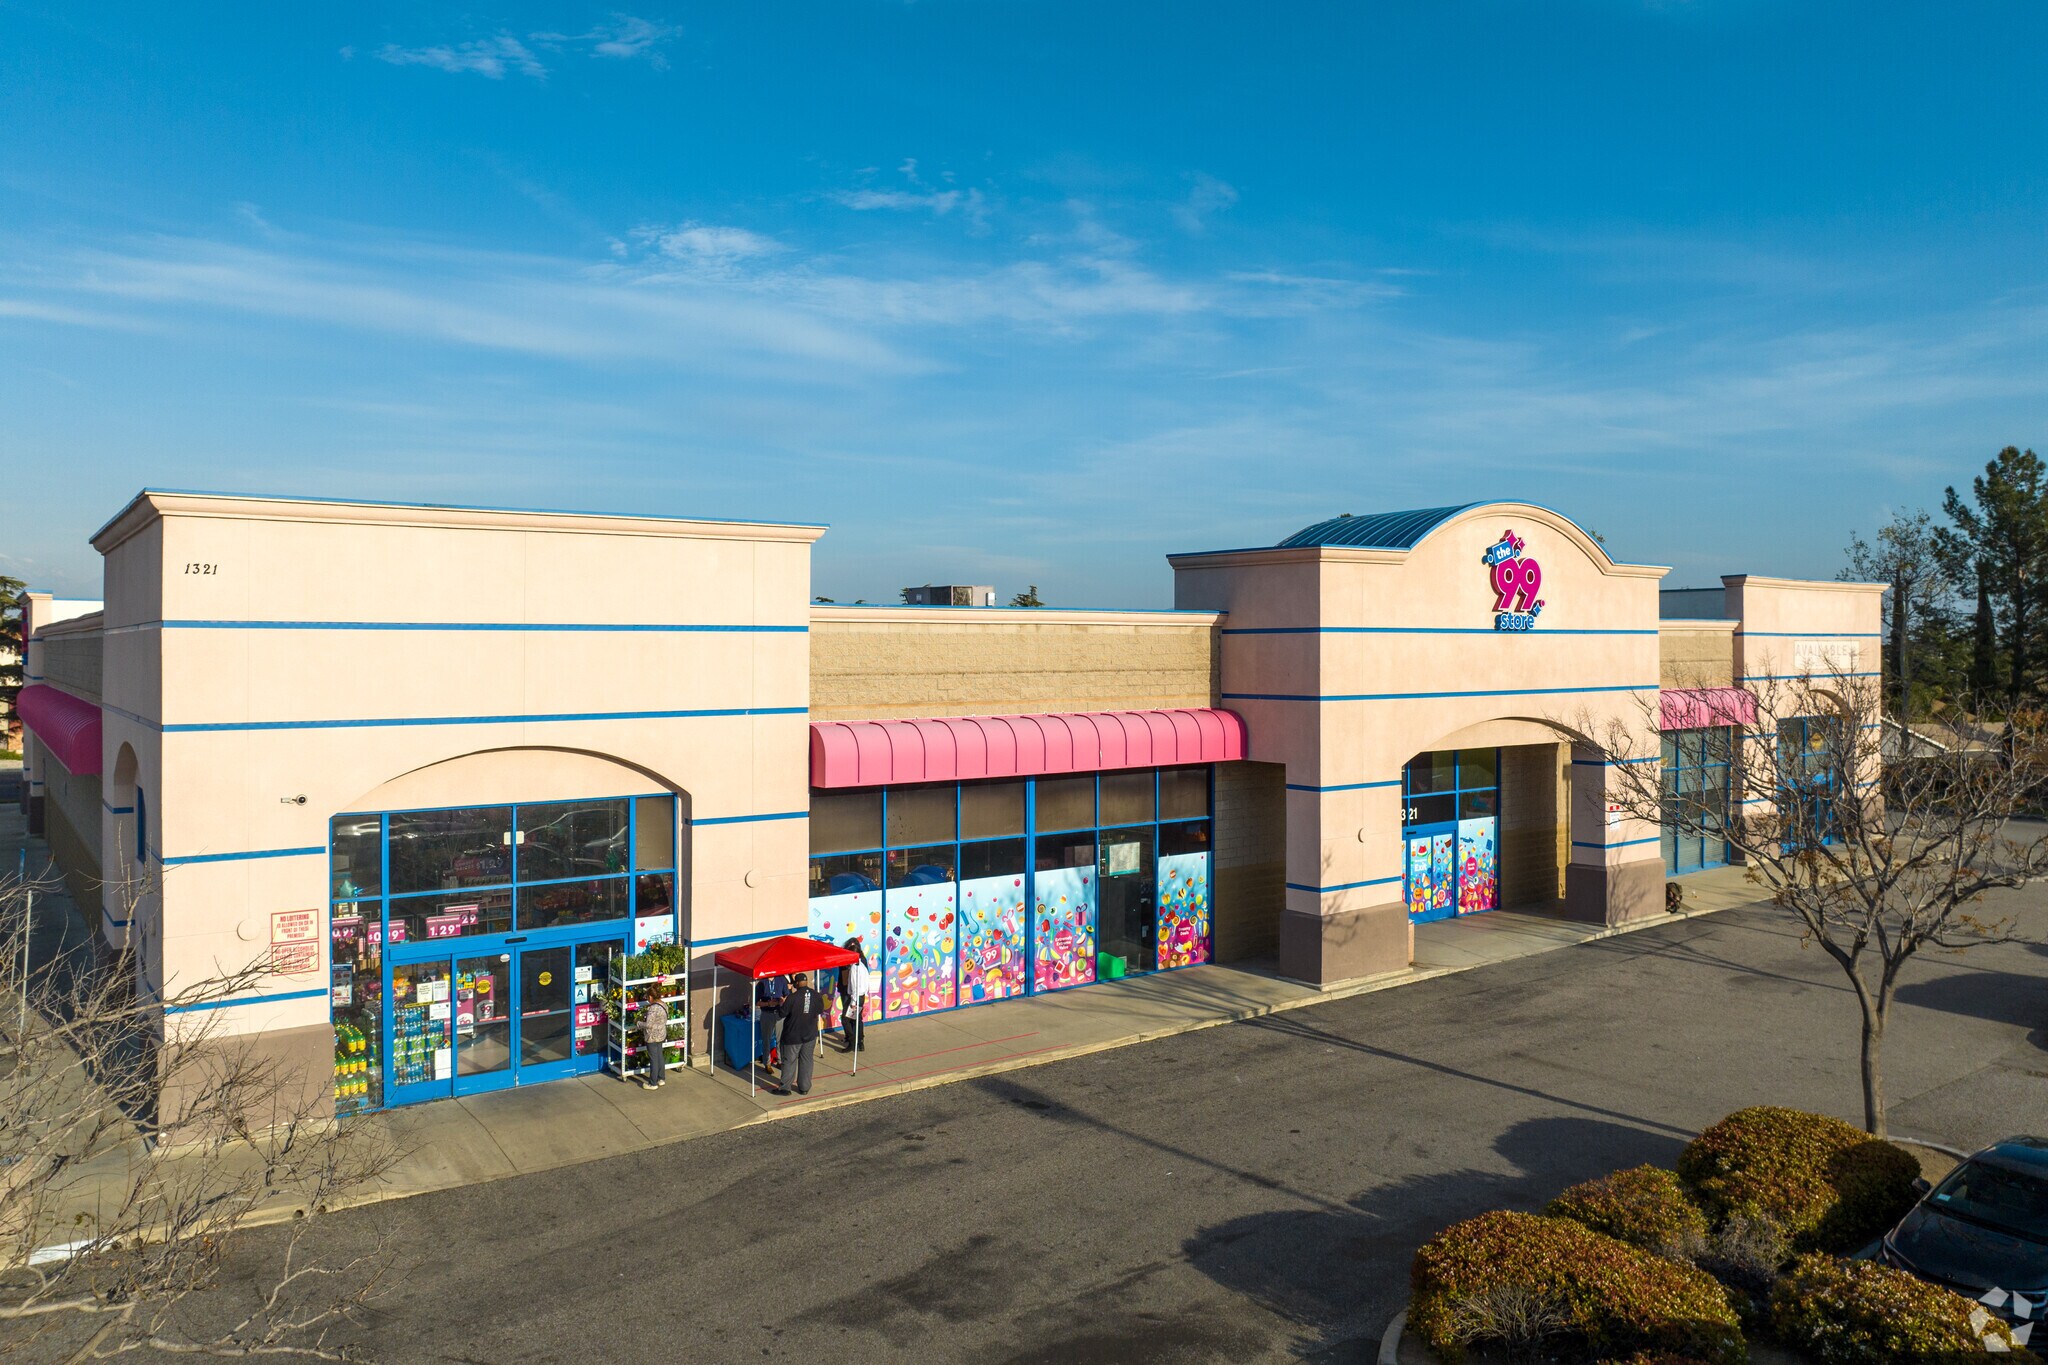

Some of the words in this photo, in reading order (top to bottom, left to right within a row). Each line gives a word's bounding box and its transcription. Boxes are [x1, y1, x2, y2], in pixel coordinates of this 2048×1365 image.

[1496, 547, 1511, 559] the
[184, 563, 218, 575] 1321
[1495, 557, 1542, 611] 99
[1500, 612, 1535, 629] store
[985, 949, 997, 962] 99
